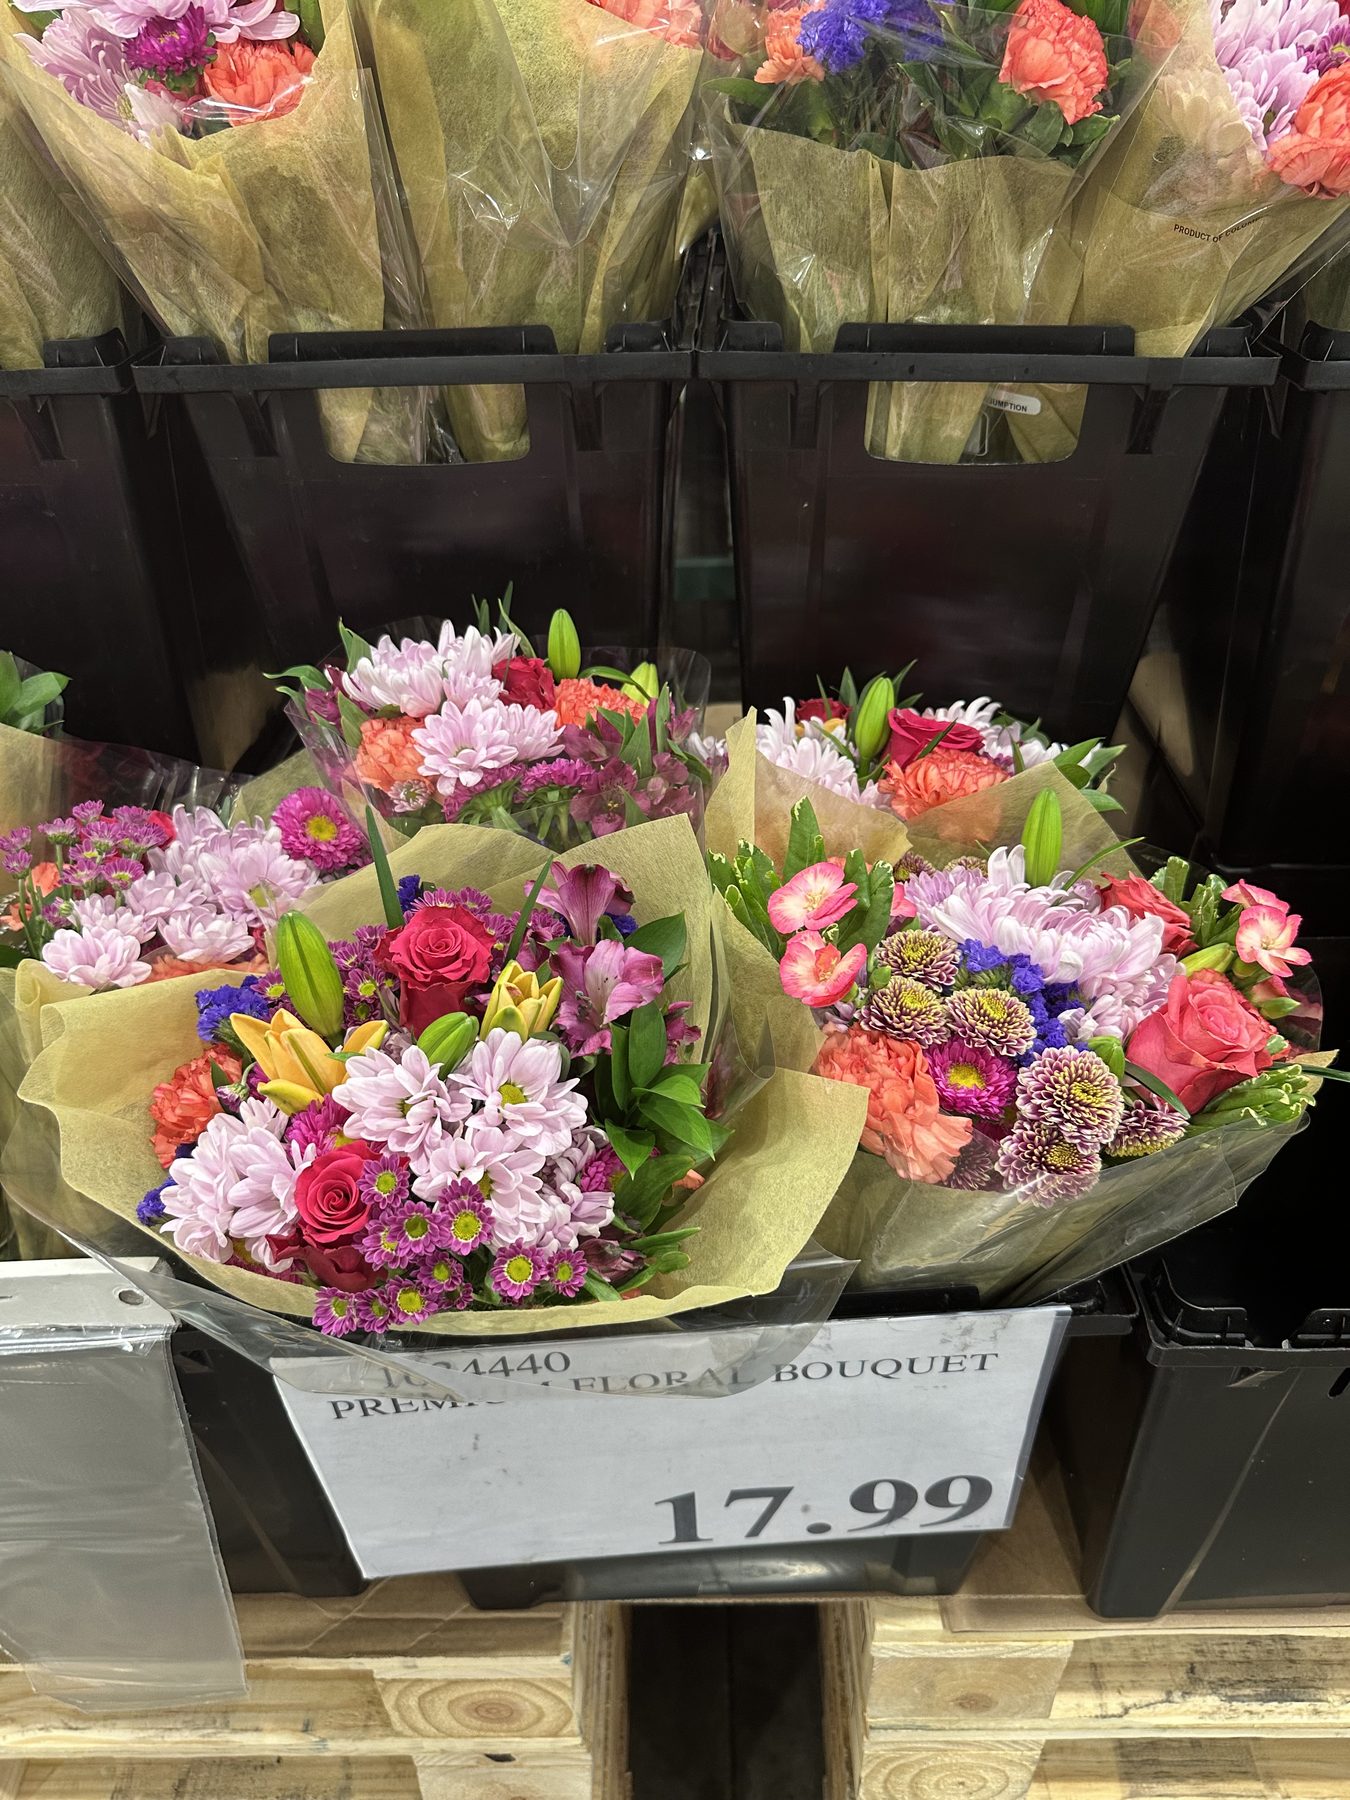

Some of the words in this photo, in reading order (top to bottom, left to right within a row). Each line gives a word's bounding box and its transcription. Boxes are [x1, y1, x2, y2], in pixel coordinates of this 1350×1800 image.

[1173, 224, 1211, 242] PRODUCT
[1212, 233, 1223, 243] OF
[990, 399, 1028, 412] UMPTION
[572, 1366, 757, 1393] FLORAL
[771, 1353, 999, 1383] BOUQUET
[654, 1474, 993, 1545] 17.99
